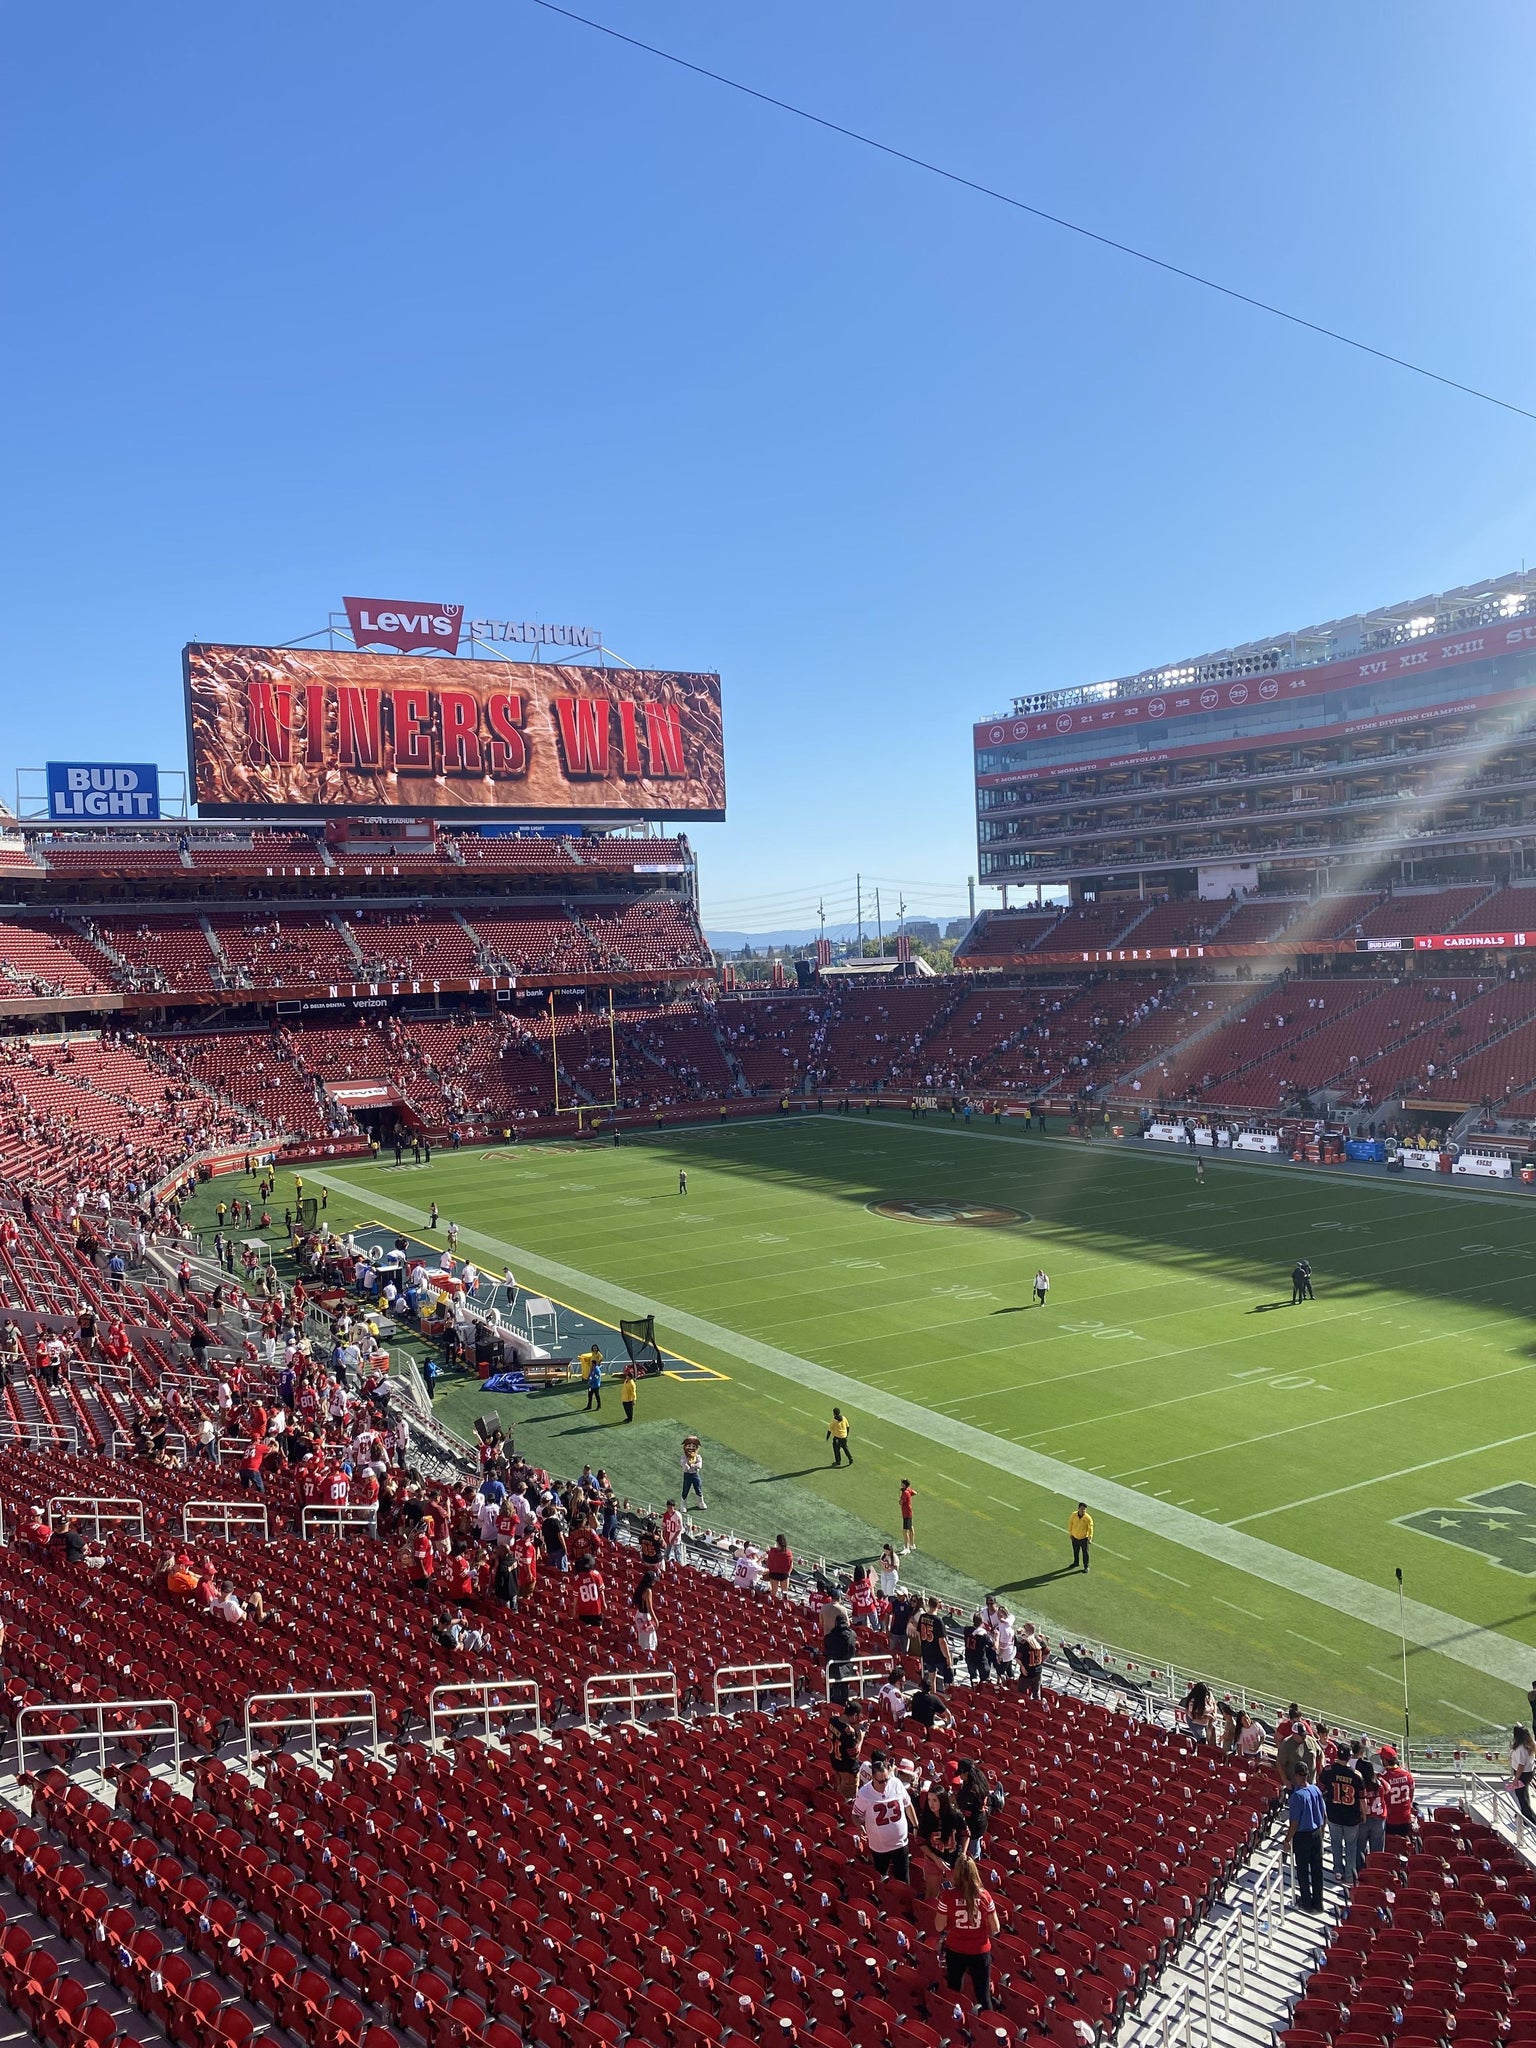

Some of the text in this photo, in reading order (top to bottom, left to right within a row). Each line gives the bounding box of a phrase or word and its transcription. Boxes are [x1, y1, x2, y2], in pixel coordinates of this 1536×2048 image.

[471, 619, 594, 647] STADIUM
[1359, 638, 1485, 677] XVI XIX XXIII
[1015, 726, 1026, 735] 12
[1036, 723, 1048, 731] 14
[1058, 718, 1070, 728] 16
[1080, 715, 1094, 723] 21
[1101, 711, 1116, 720] 27
[1124, 707, 1139, 716] 33
[1149, 702, 1164, 712] 34
[1175, 699, 1190, 708] 35
[1202, 693, 1217, 703] 37
[1230, 689, 1246, 699] 39
[1260, 684, 1277, 693] 42
[1289, 679, 1307, 689] 44
[1379, 714, 1420, 727] DIVISION
[1421, 703, 1477, 719] CHAMPIONS
[247, 682, 687, 777] NINERS WIN
[67, 768, 139, 792] BUD
[54, 791, 153, 815] LIGHT
[266, 866, 400, 876] NINERS WIN
[1427, 938, 1433, 949] 2
[1444, 933, 1526, 947] CARDINALS 15
[1083, 947, 1204, 962] NINERS WIN
[329, 977, 517, 998] NINERS WIN
[526, 989, 544, 997] bank
[561, 988, 586, 997] NetApp
[352, 998, 387, 1008] verizon
[1476, 1159, 1493, 1167] 49ERS
[931, 1284, 993, 1300] 30
[1058, 1320, 1135, 1340] 20
[1227, 1365, 1316, 1390] 10
[300, 1395, 314, 1408] 80
[330, 1481, 348, 1500] 80
[500, 1521, 511, 1531] 21
[735, 1564, 748, 1578] 30
[579, 1583, 599, 1603] 80
[1331, 1781, 1355, 1806] 13
[1390, 1785, 1410, 1805] 23
[872, 1799, 901, 1827] 23
[955, 1909, 982, 1930] 23
